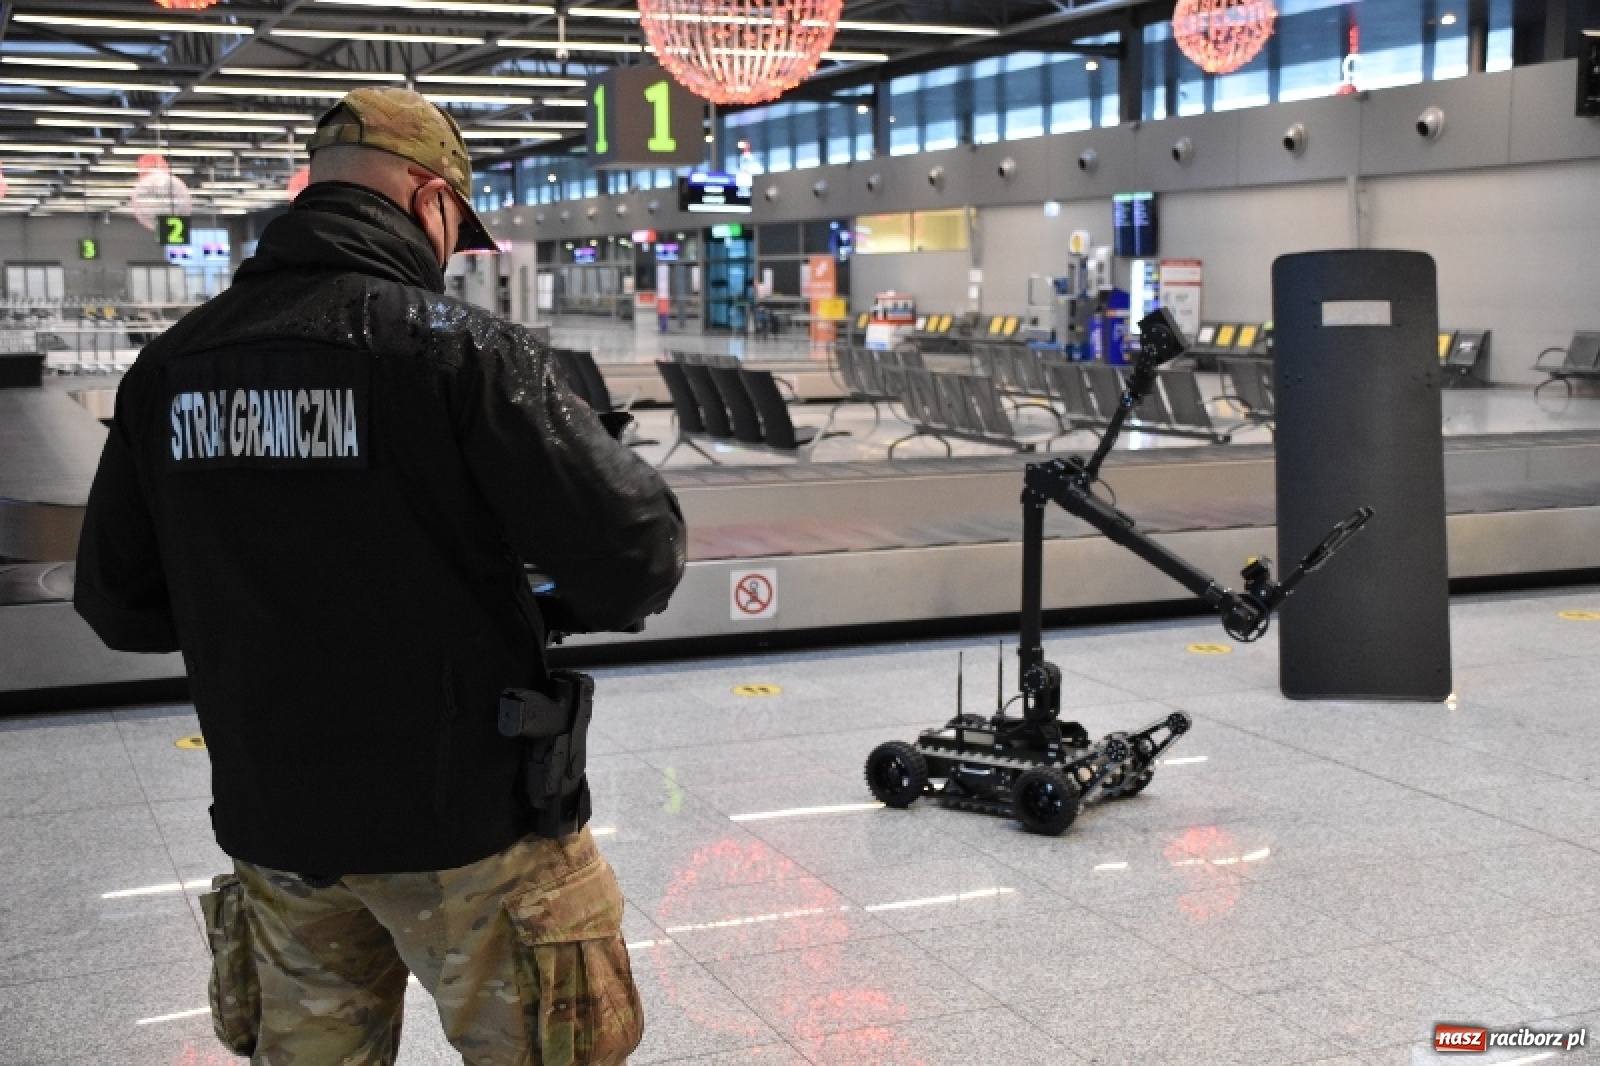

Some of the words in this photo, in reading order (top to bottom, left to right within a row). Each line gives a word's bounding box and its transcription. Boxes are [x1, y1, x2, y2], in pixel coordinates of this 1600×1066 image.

[593, 84, 609, 154] 1
[643, 80, 677, 153] 1
[82, 239, 96, 259] 3
[166, 217, 185, 243] 2
[230, 388, 359, 459] GRANICZNA
